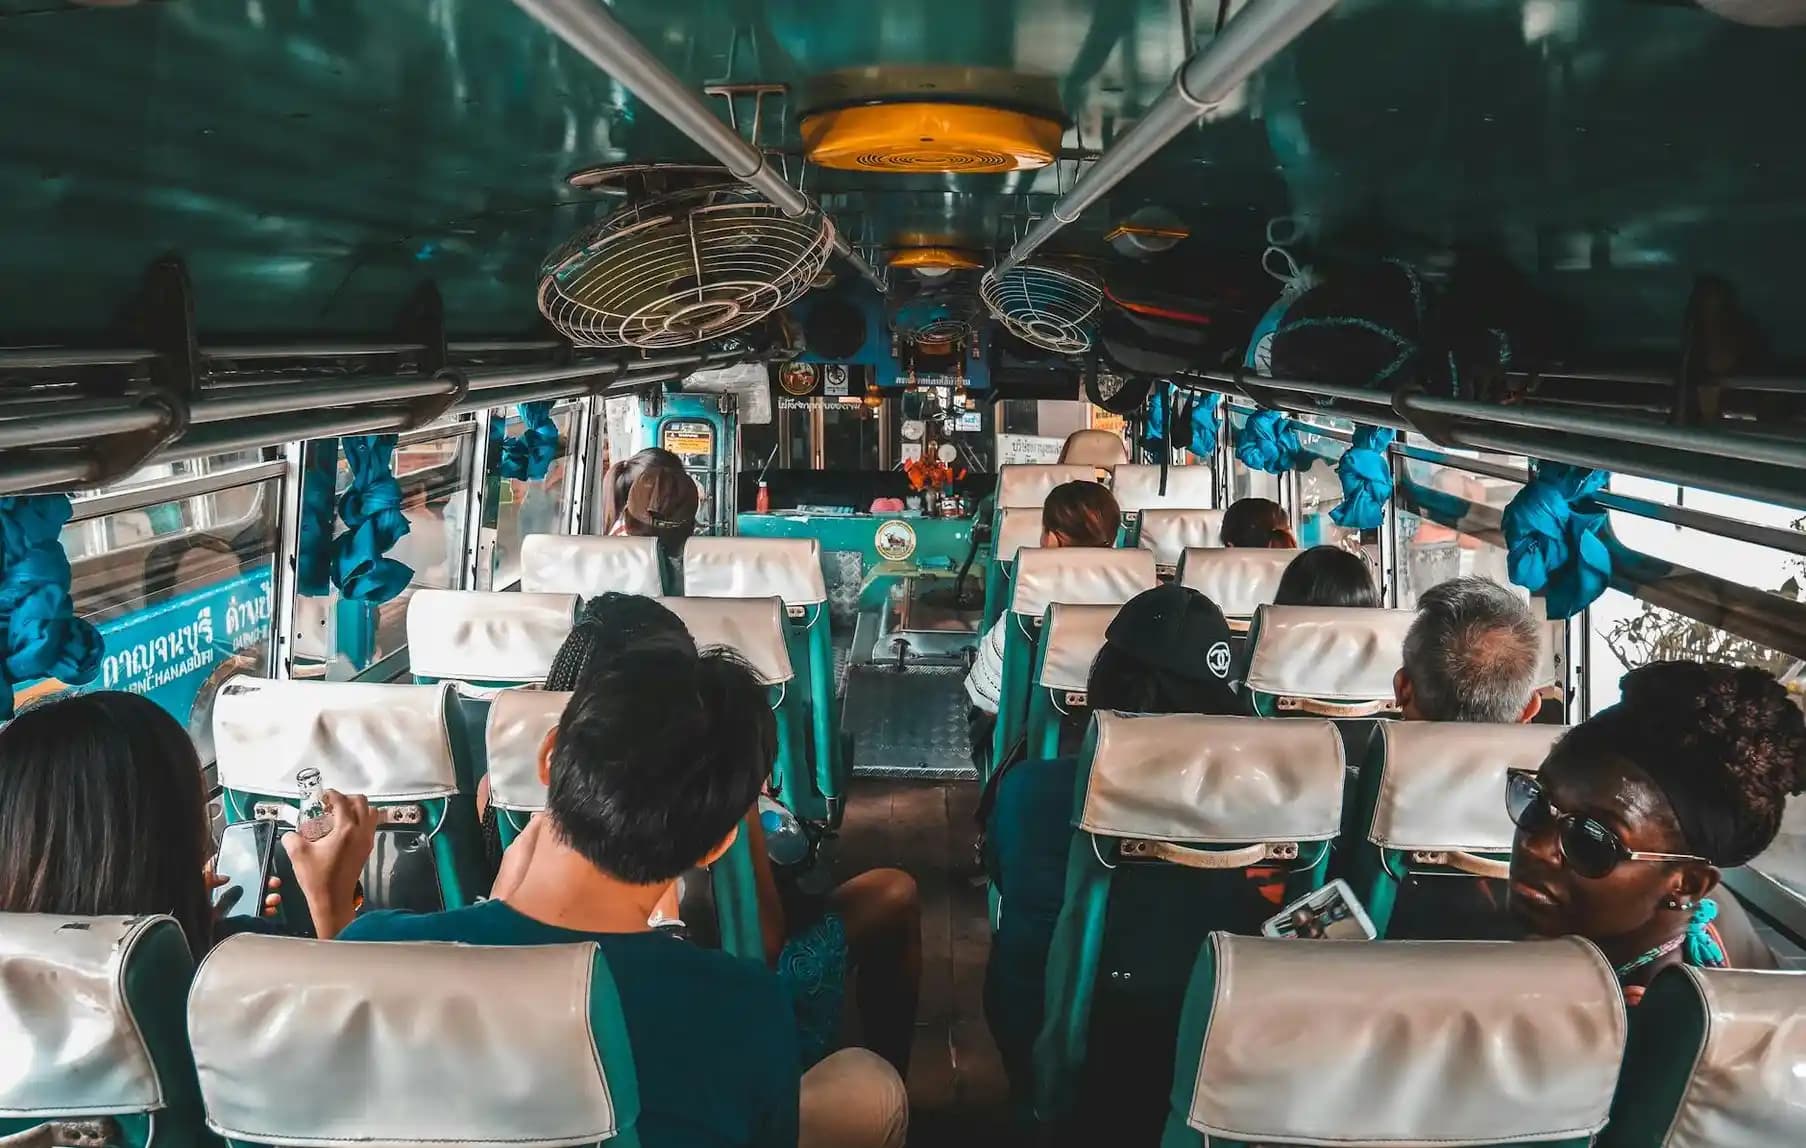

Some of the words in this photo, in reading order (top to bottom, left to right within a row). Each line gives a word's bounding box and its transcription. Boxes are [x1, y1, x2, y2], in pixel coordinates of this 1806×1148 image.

[103, 606, 214, 688] กาญจนบุรี
[123, 648, 214, 695] ANCHANABURI
